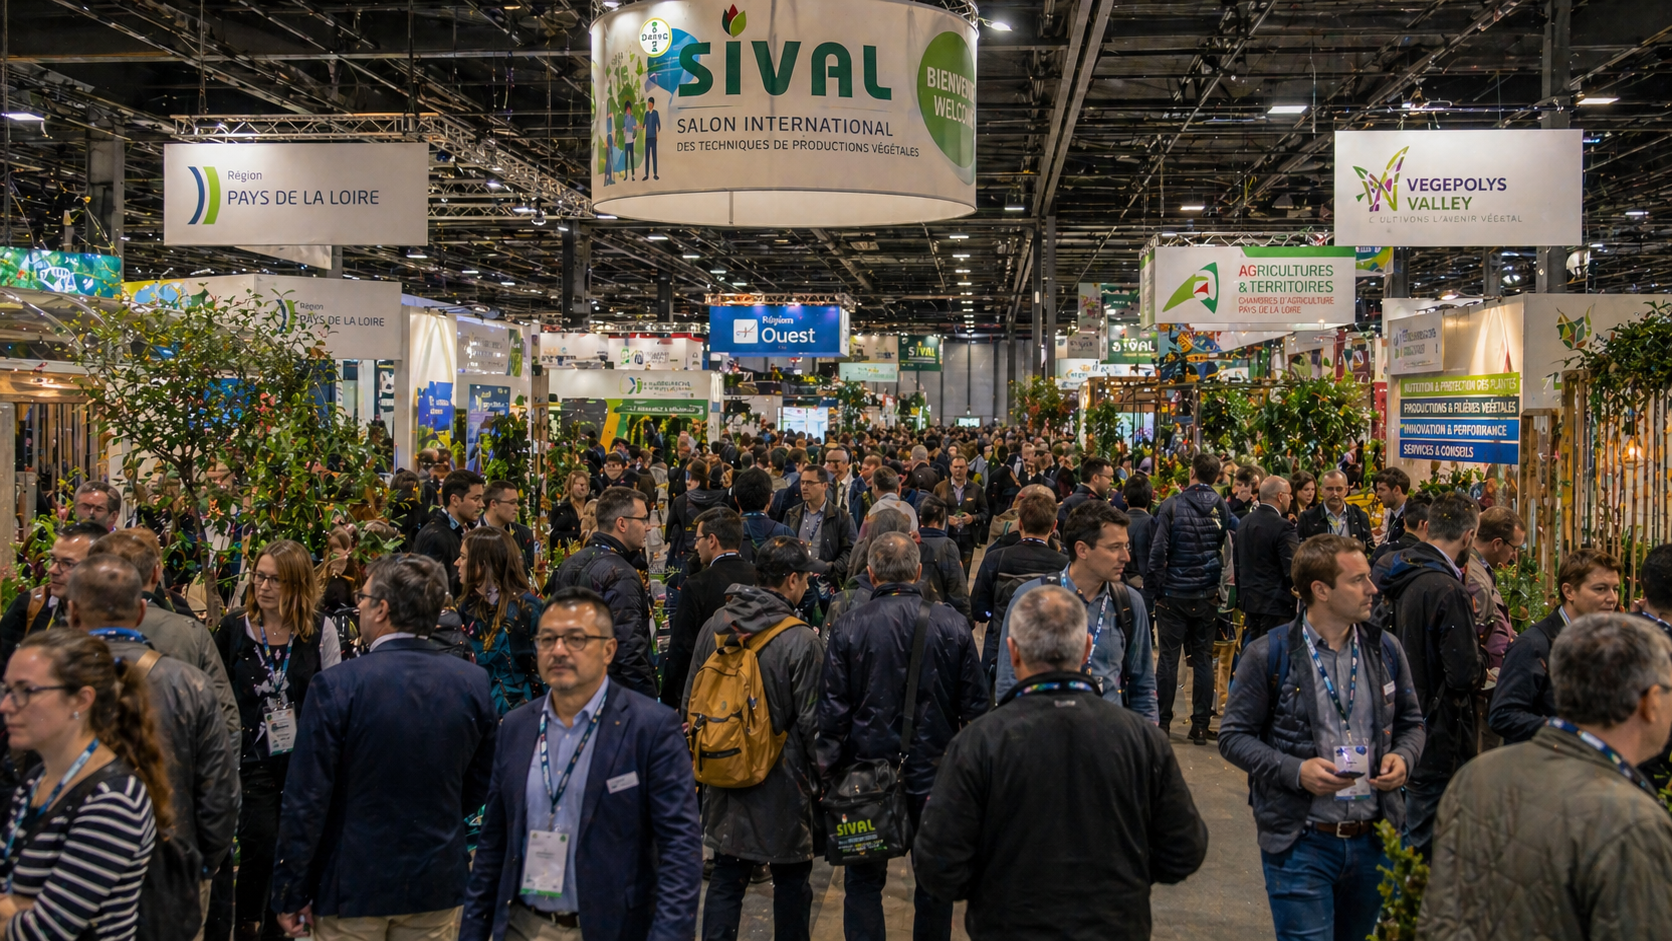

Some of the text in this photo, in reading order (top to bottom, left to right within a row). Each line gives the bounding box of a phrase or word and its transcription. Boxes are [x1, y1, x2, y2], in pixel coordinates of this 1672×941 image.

[677, 116, 893, 136] SALON INTERNATIONAL
[676, 140, 919, 157] DES TECHNIQUES DE PRODUCTIONS VÉGÉTALES
[227, 169, 263, 183] Région
[1407, 178, 1507, 192] VEGEPOLYS
[227, 189, 379, 205] PAYS DE LA LOIRE
[1407, 196, 1472, 210] VALLEY
[1239, 264, 1334, 277] AGRICULTURES
[1239, 280, 1334, 293] & TERRITOIRES
[299, 314, 385, 327] PAYS DE LA LOIRE
[761, 327, 816, 344] Ouest
